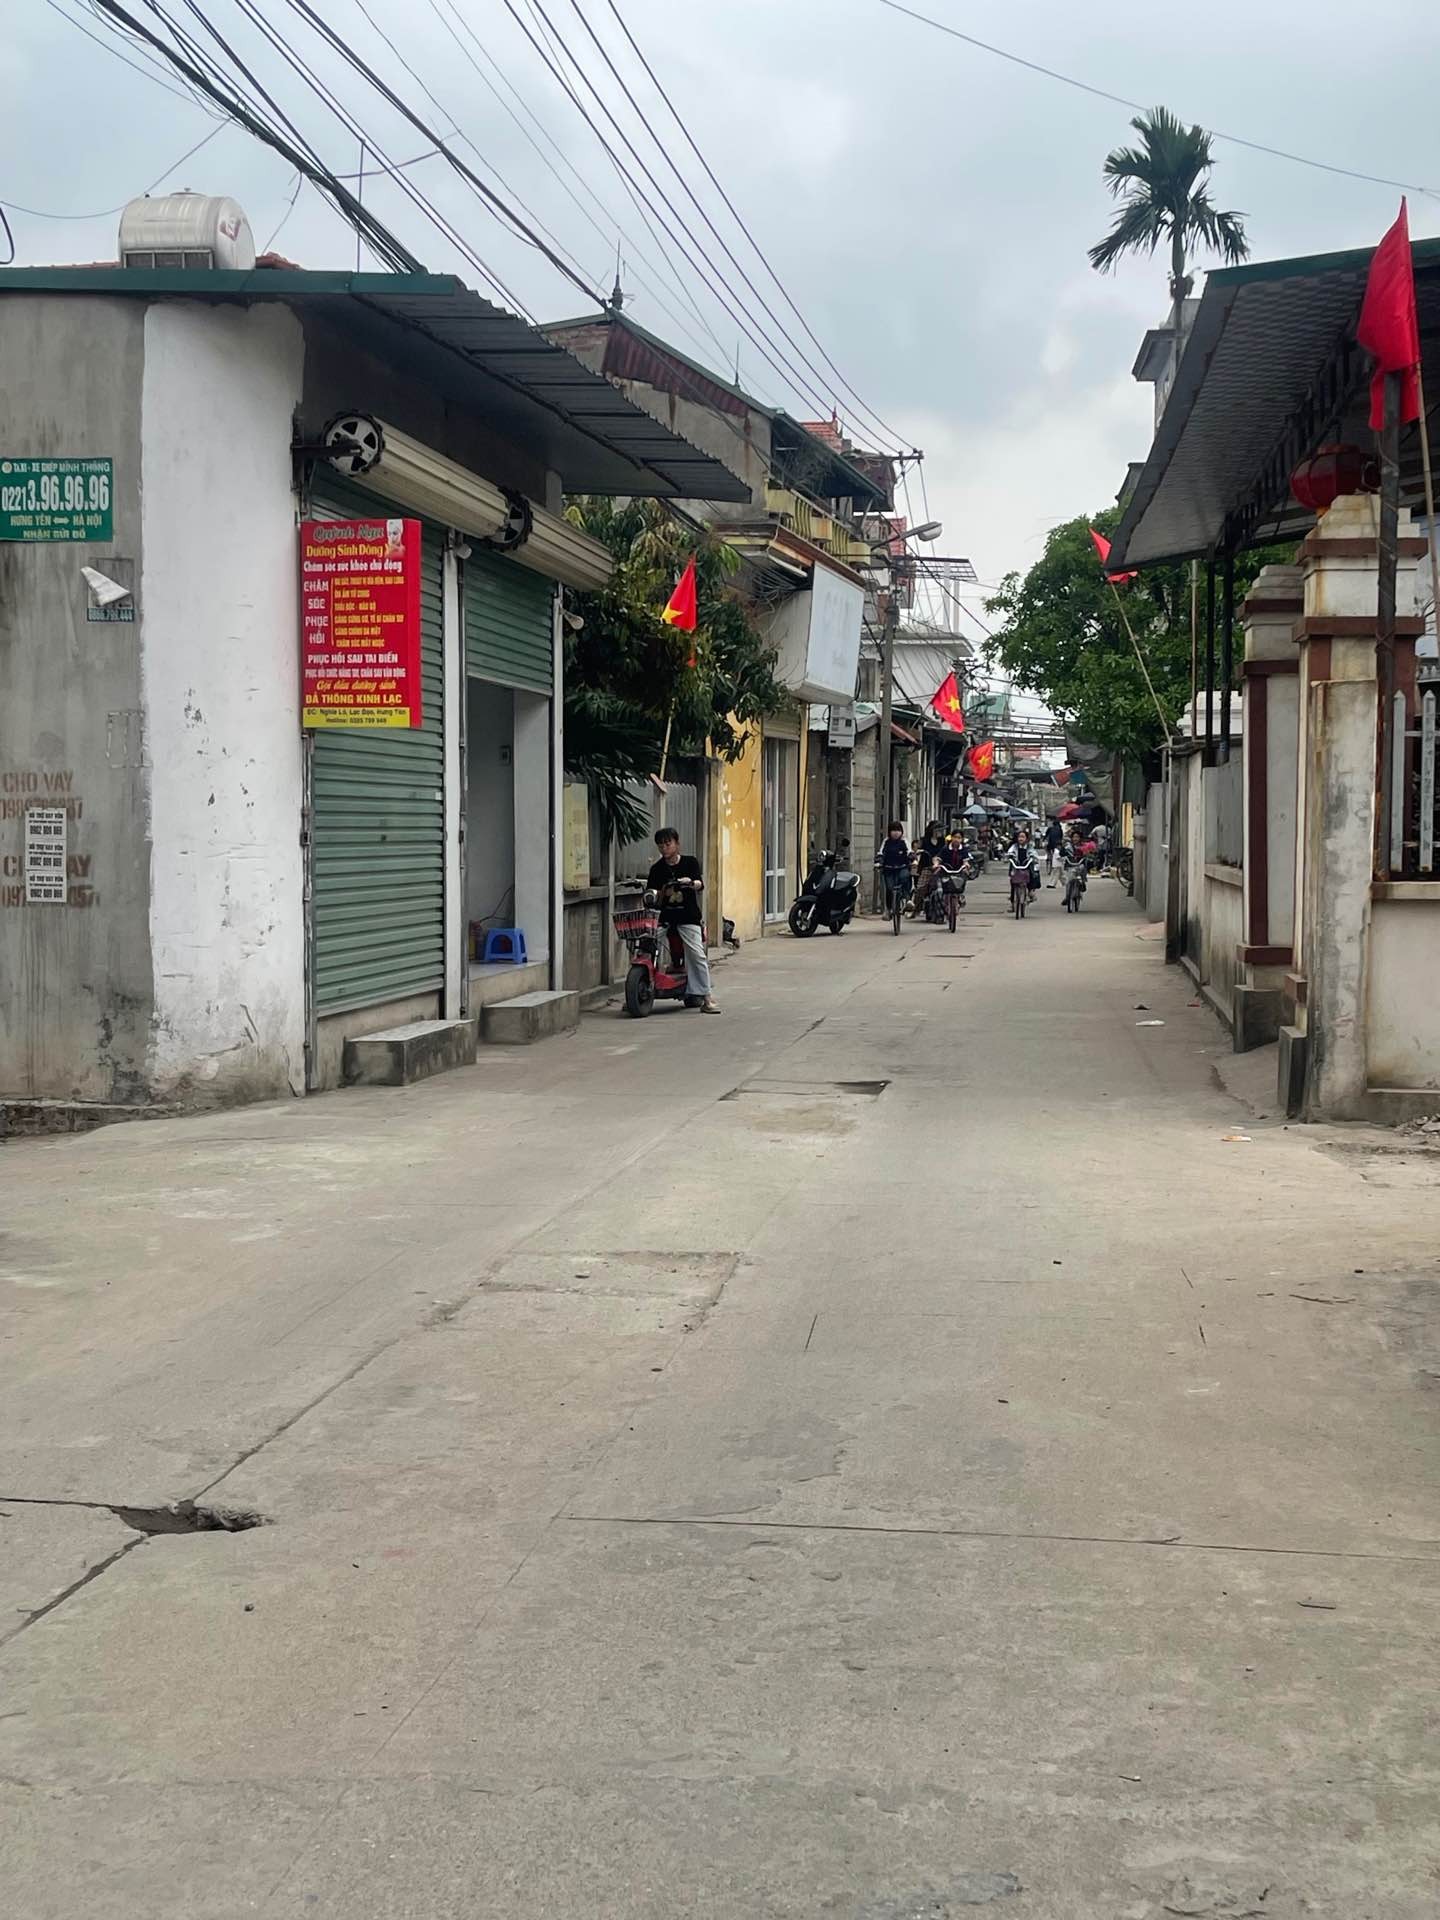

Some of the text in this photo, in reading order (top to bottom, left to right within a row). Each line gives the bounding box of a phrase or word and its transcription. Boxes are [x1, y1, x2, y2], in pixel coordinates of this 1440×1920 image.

[337, 544, 358, 556] Sinh
[347, 653, 363, 664] SAU
[365, 653, 377, 664] TAI
[356, 694, 381, 704] KINH
[383, 694, 402, 706] LẠC
[3, 768, 74, 793] CHO VAY
